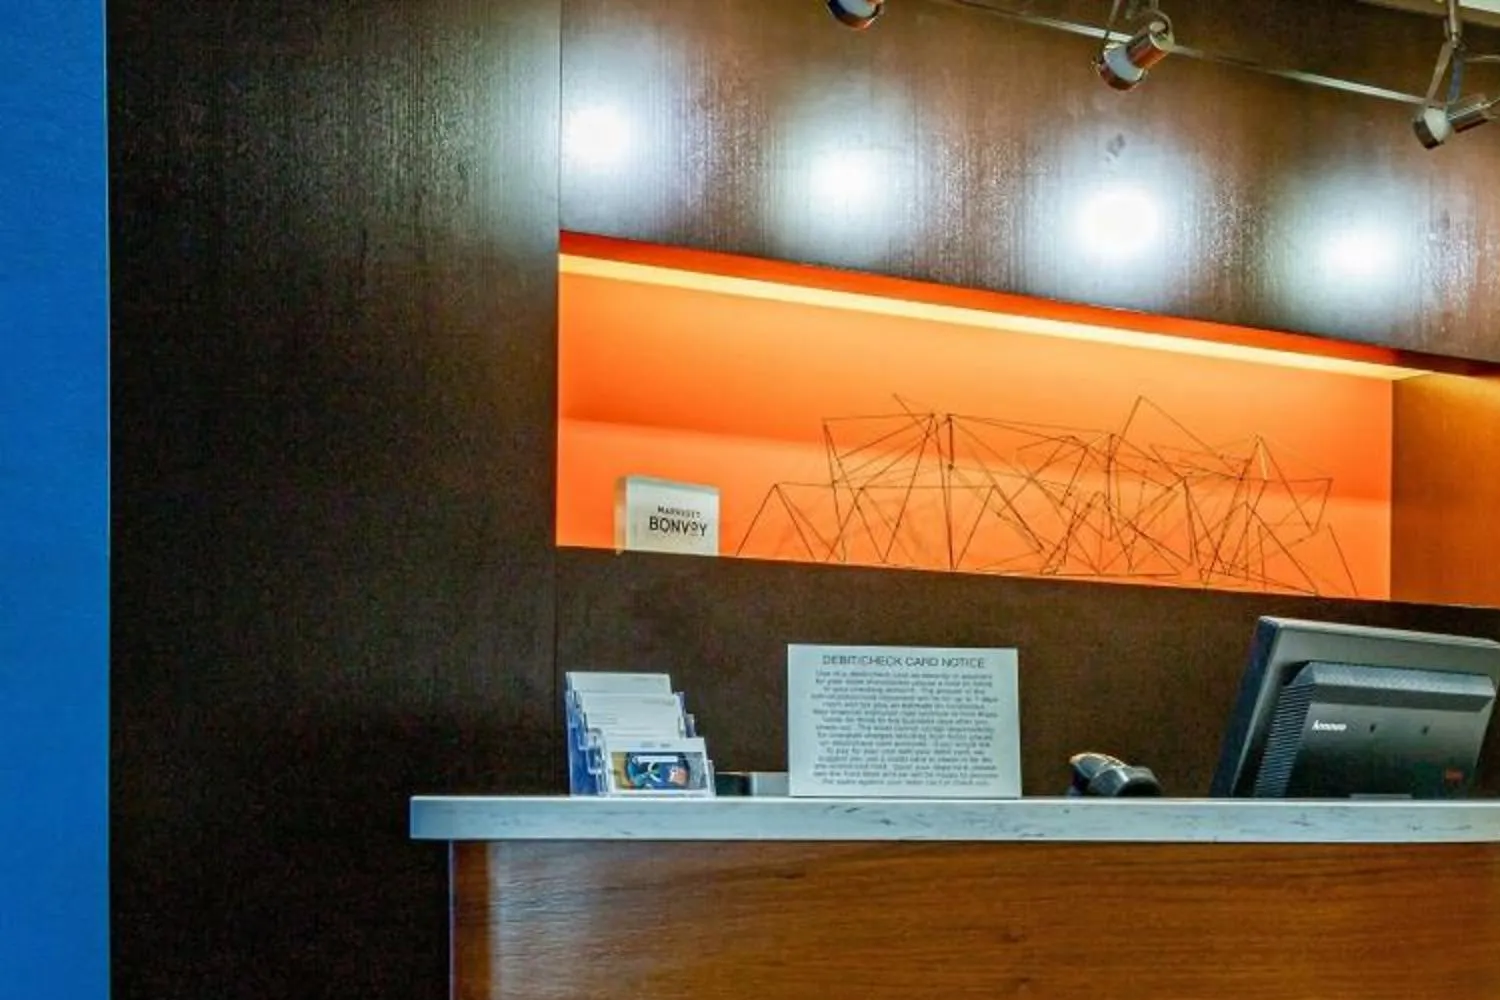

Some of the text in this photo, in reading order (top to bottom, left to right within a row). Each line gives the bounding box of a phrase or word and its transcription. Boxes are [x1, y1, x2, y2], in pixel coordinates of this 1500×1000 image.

[822, 655, 985, 668] DEBIT/CHECK CARD NOTICE
